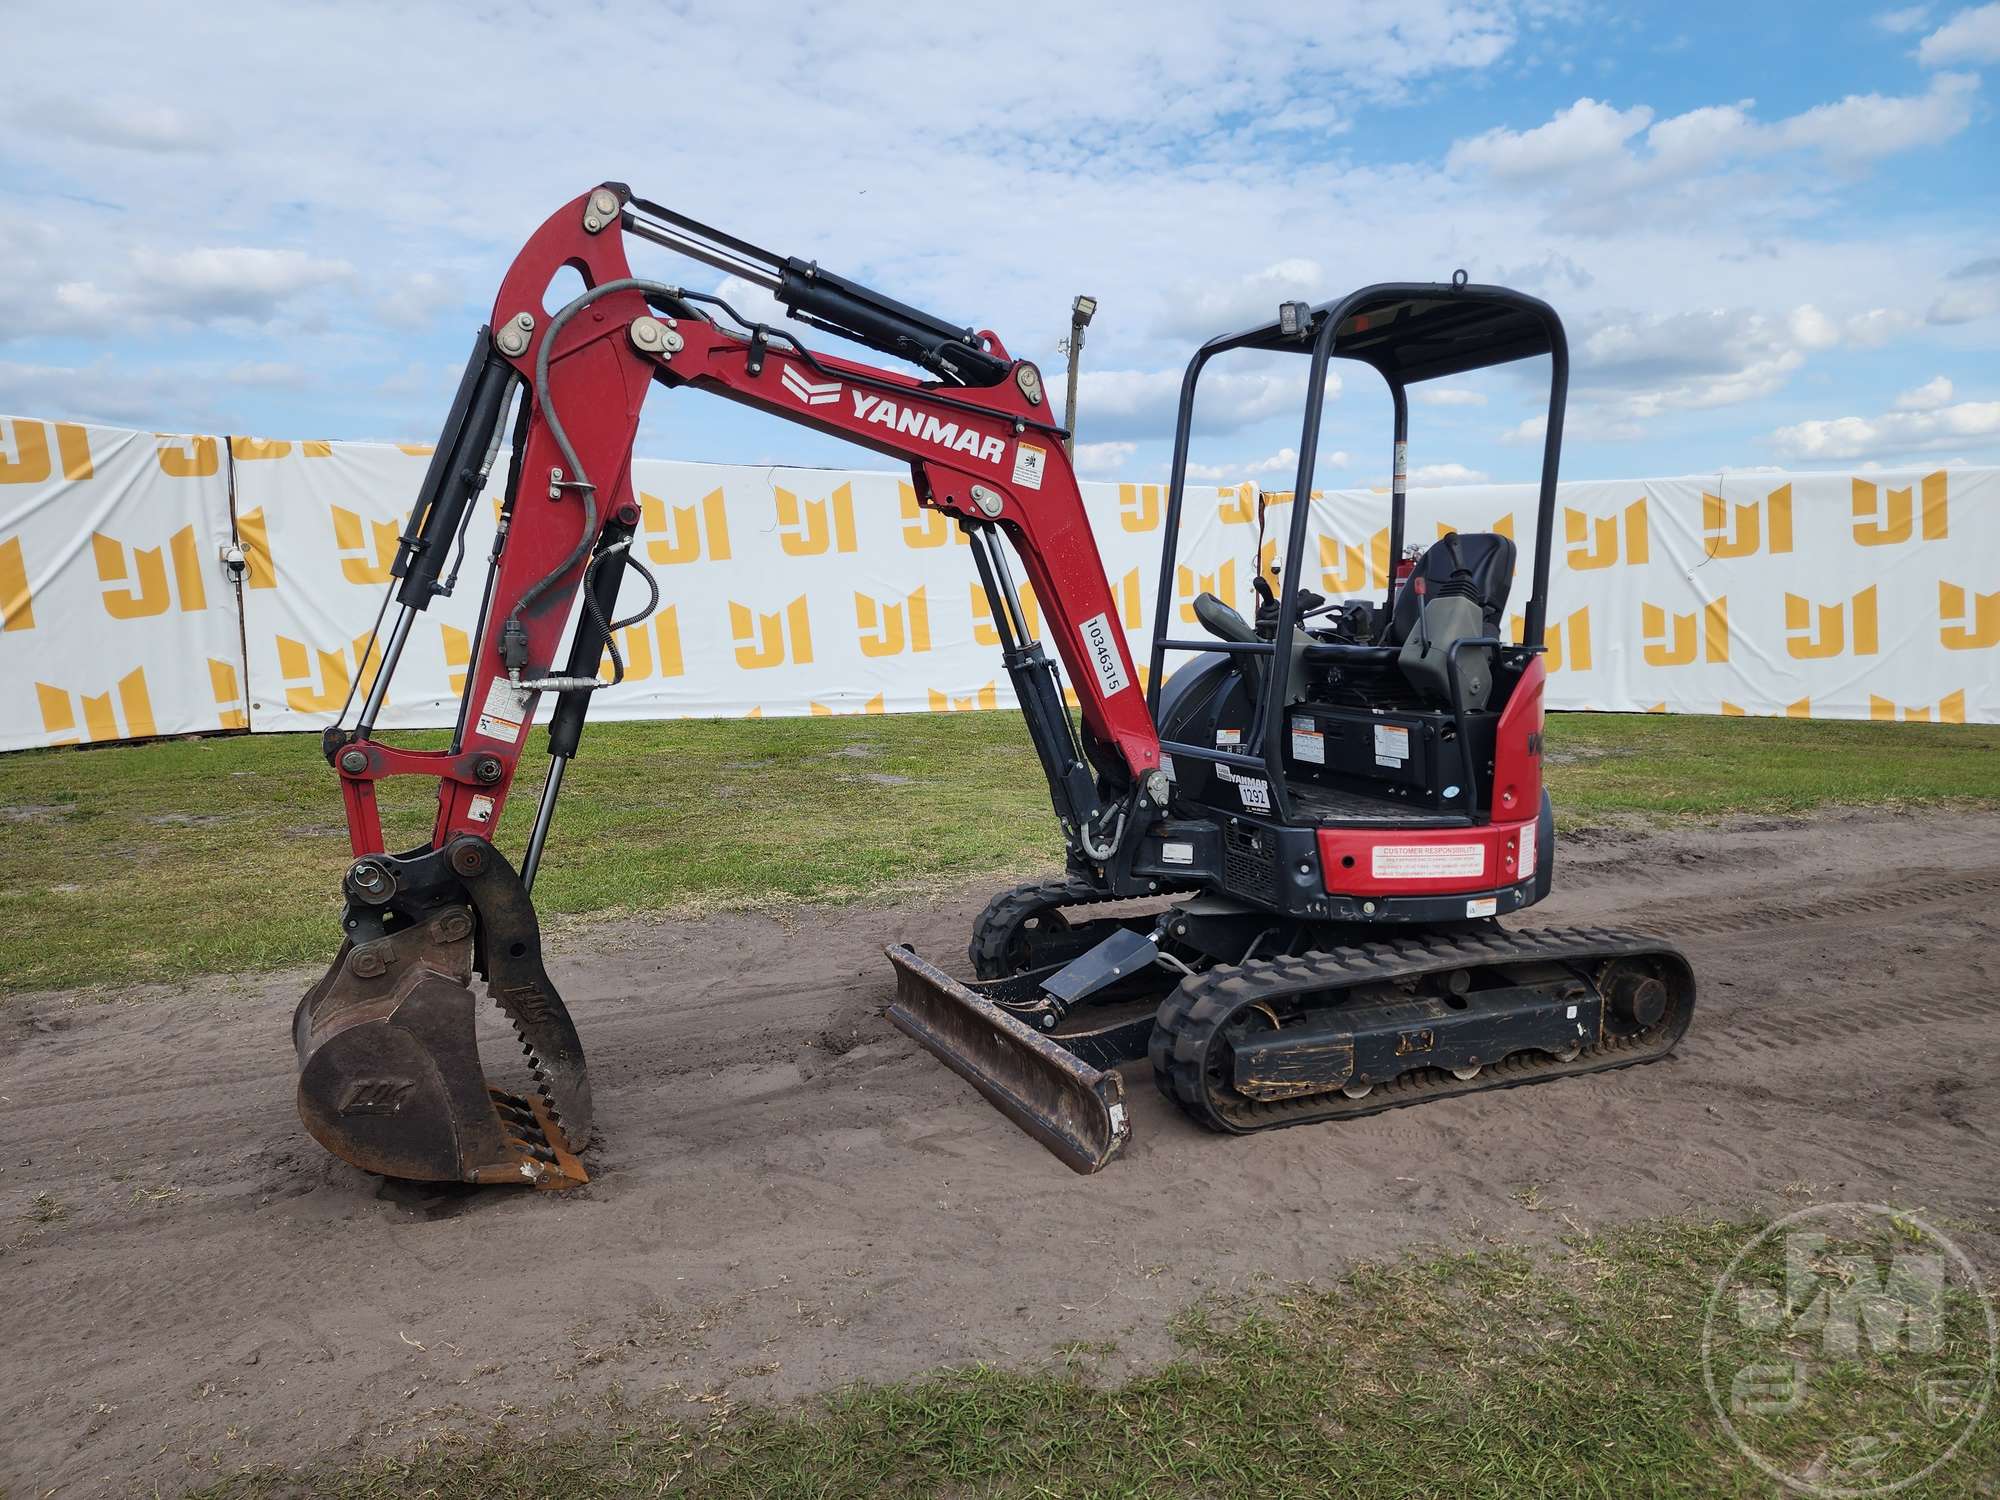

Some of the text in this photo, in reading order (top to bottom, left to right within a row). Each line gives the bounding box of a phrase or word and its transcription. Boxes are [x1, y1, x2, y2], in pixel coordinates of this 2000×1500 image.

[852, 389, 1006, 464] YANMAR
[1087, 619, 1120, 690] 10346315
[1230, 773, 1268, 790] YANMAR
[1243, 788, 1266, 804] 1292
[1383, 847, 1424, 855] CUSTOMER
